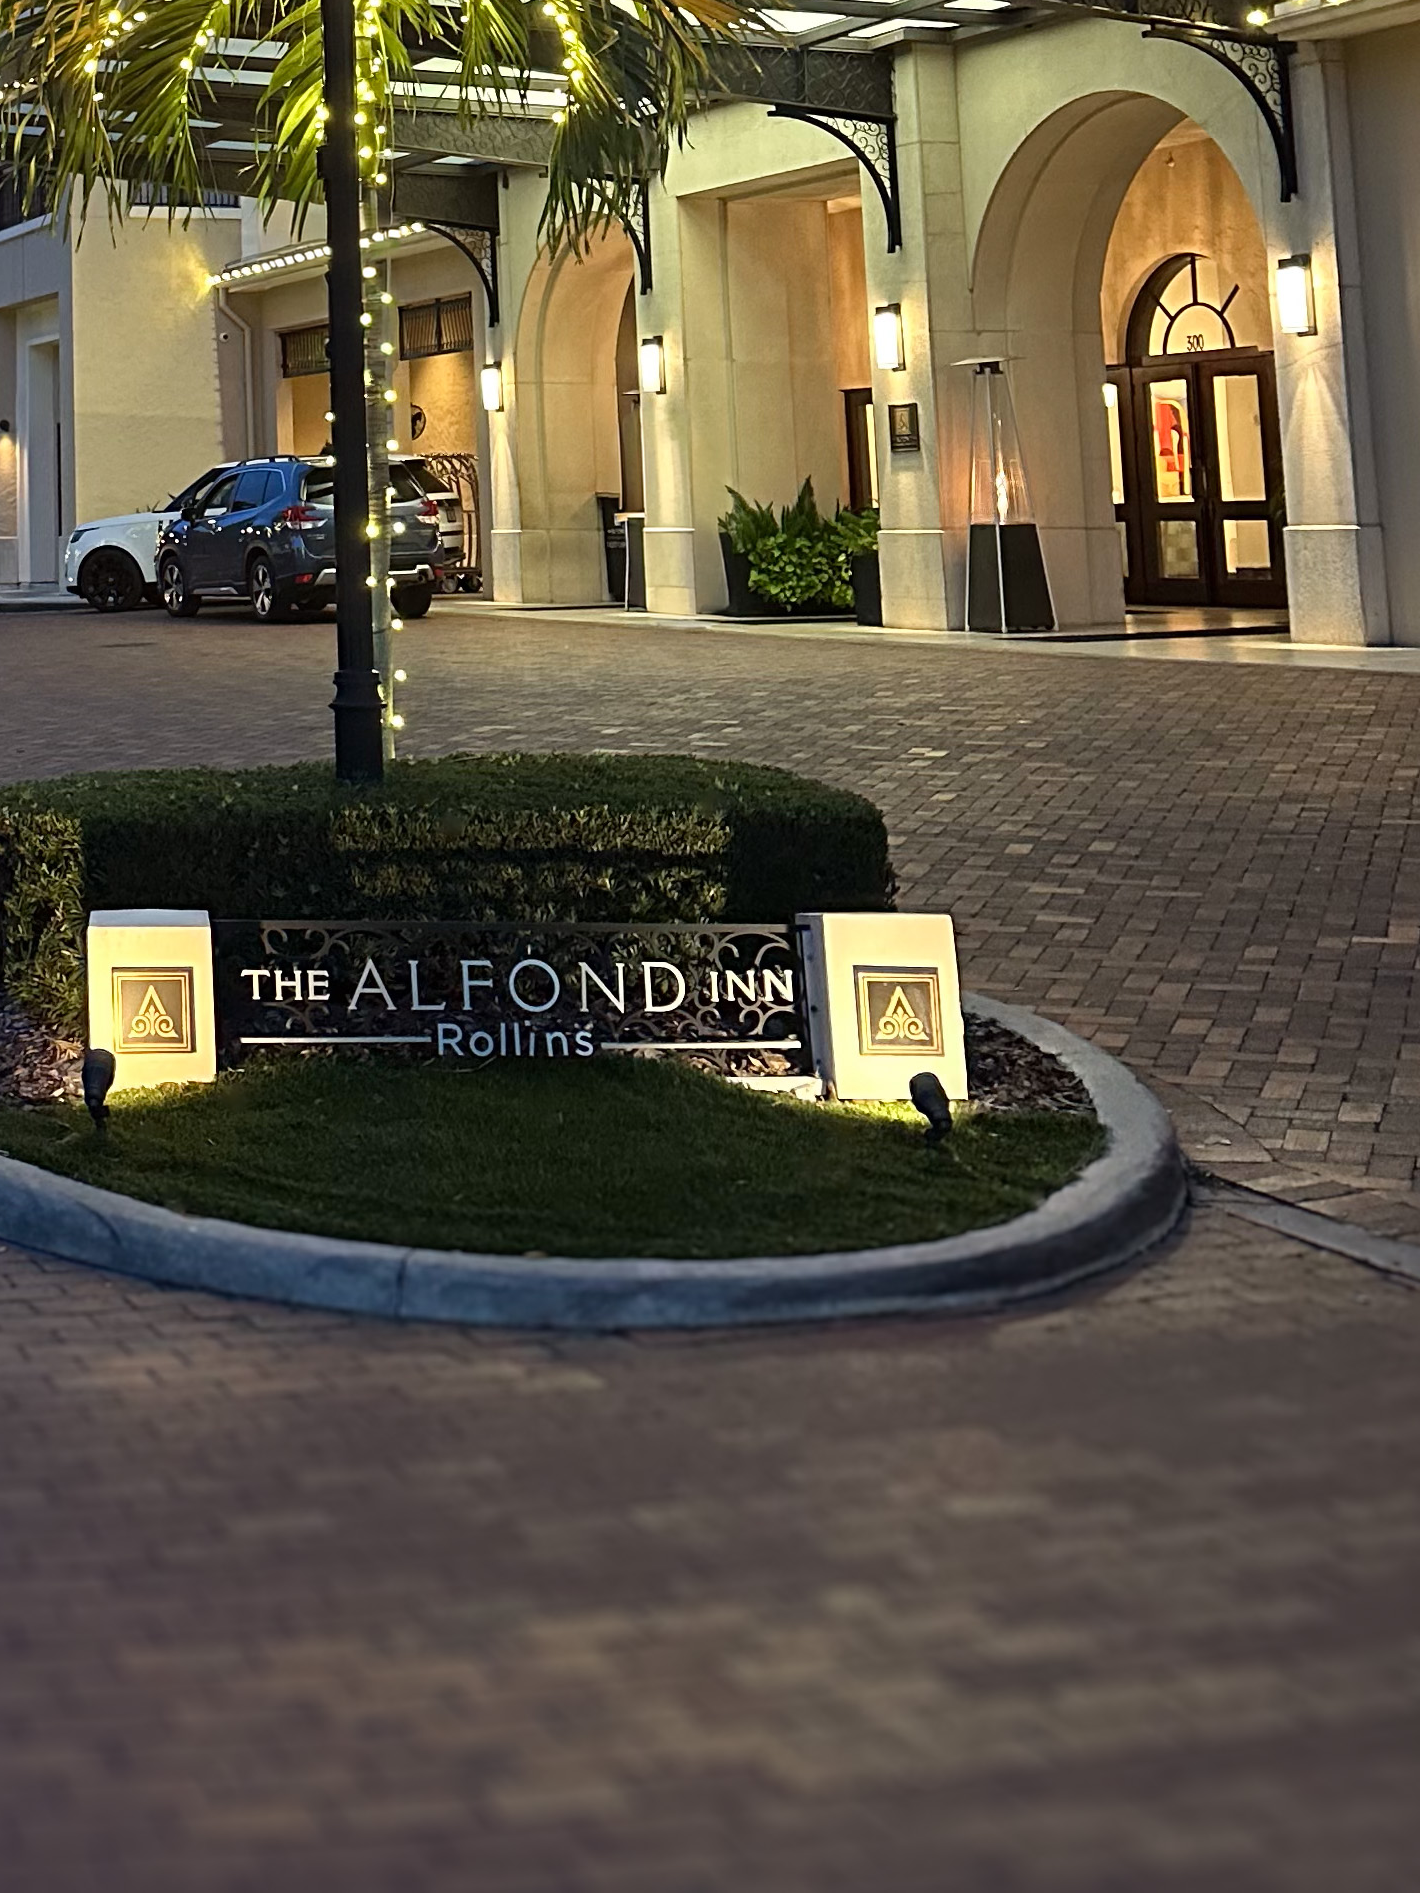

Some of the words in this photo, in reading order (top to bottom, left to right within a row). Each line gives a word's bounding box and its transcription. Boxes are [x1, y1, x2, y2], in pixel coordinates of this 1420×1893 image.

[1186, 333, 1205, 352] 300
[240, 968, 331, 1001] THE
[346, 957, 686, 1014] ALFOND
[709, 968, 794, 1003] INN
[436, 1021, 595, 1058] Rollins
